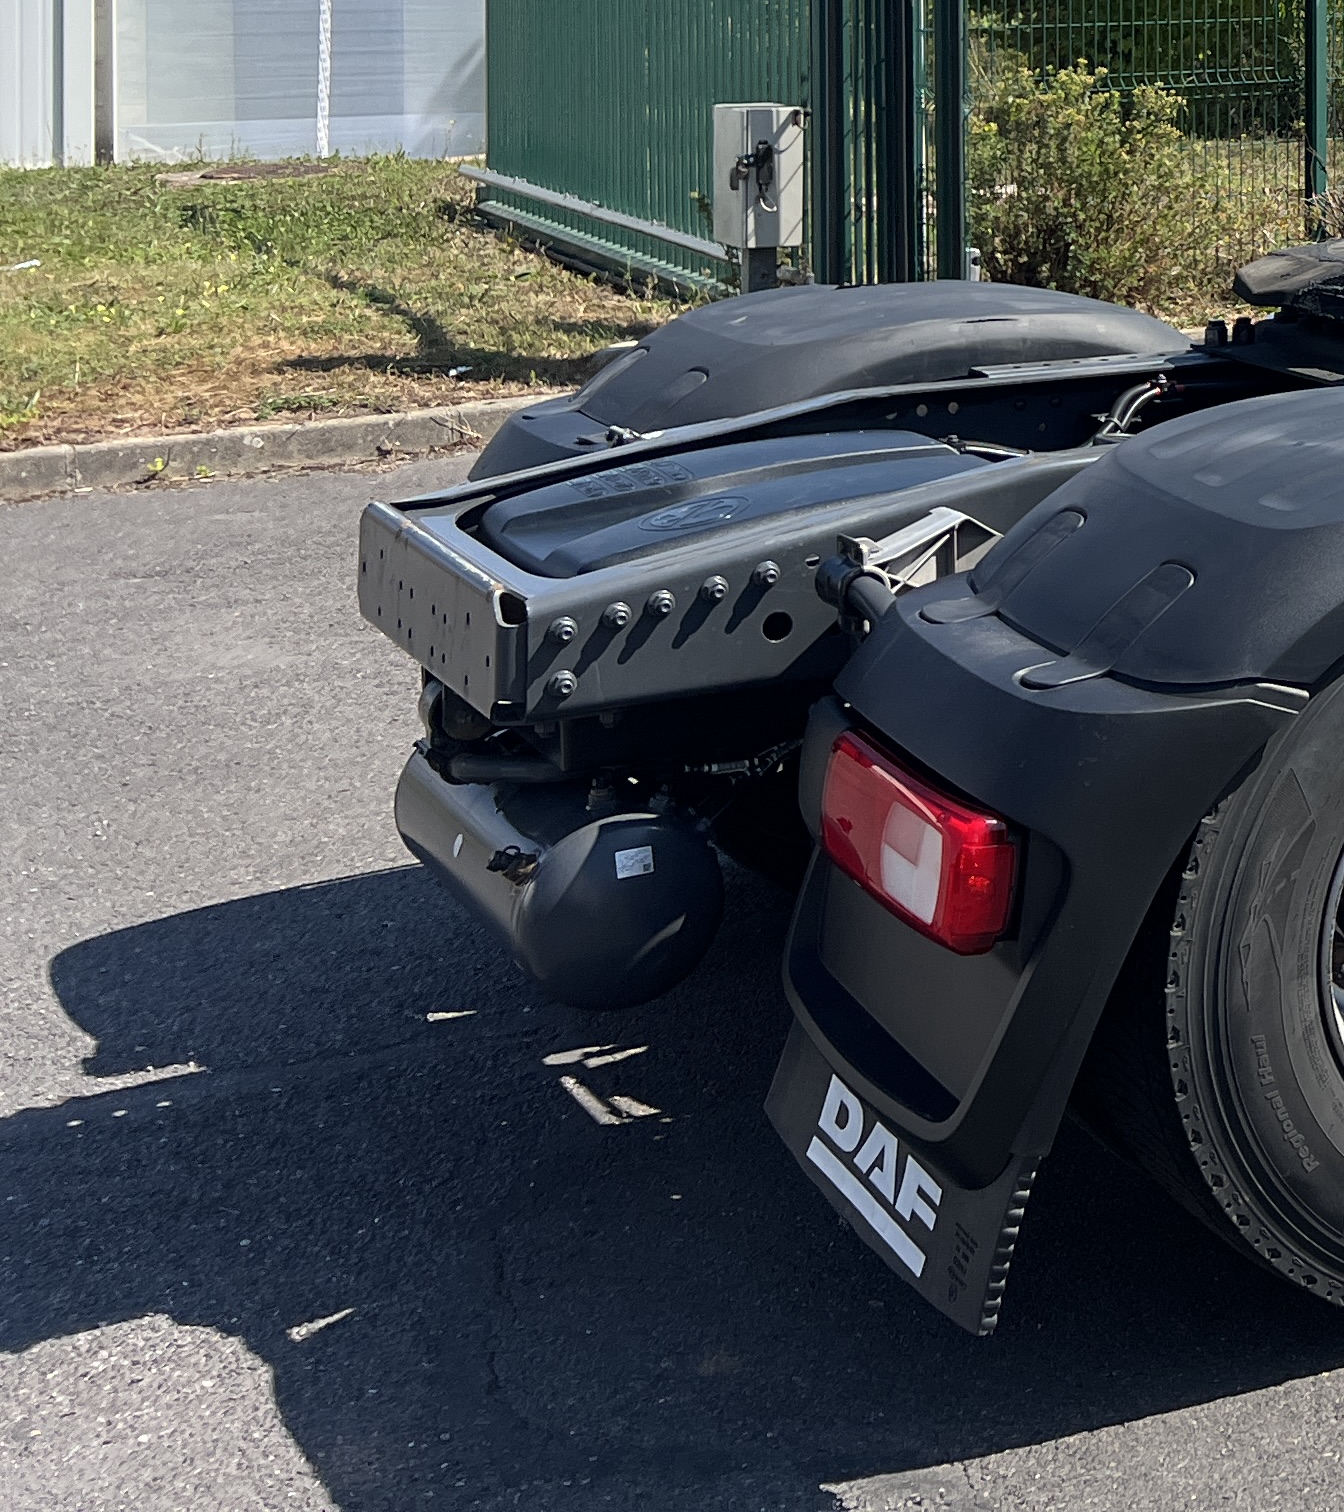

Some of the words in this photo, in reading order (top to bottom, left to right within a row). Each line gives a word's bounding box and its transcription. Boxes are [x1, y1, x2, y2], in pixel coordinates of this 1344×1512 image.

[1251, 1034, 1275, 1087] Haul
[818, 1073, 942, 1231] DAF
[1264, 1088, 1320, 1173] Regional
